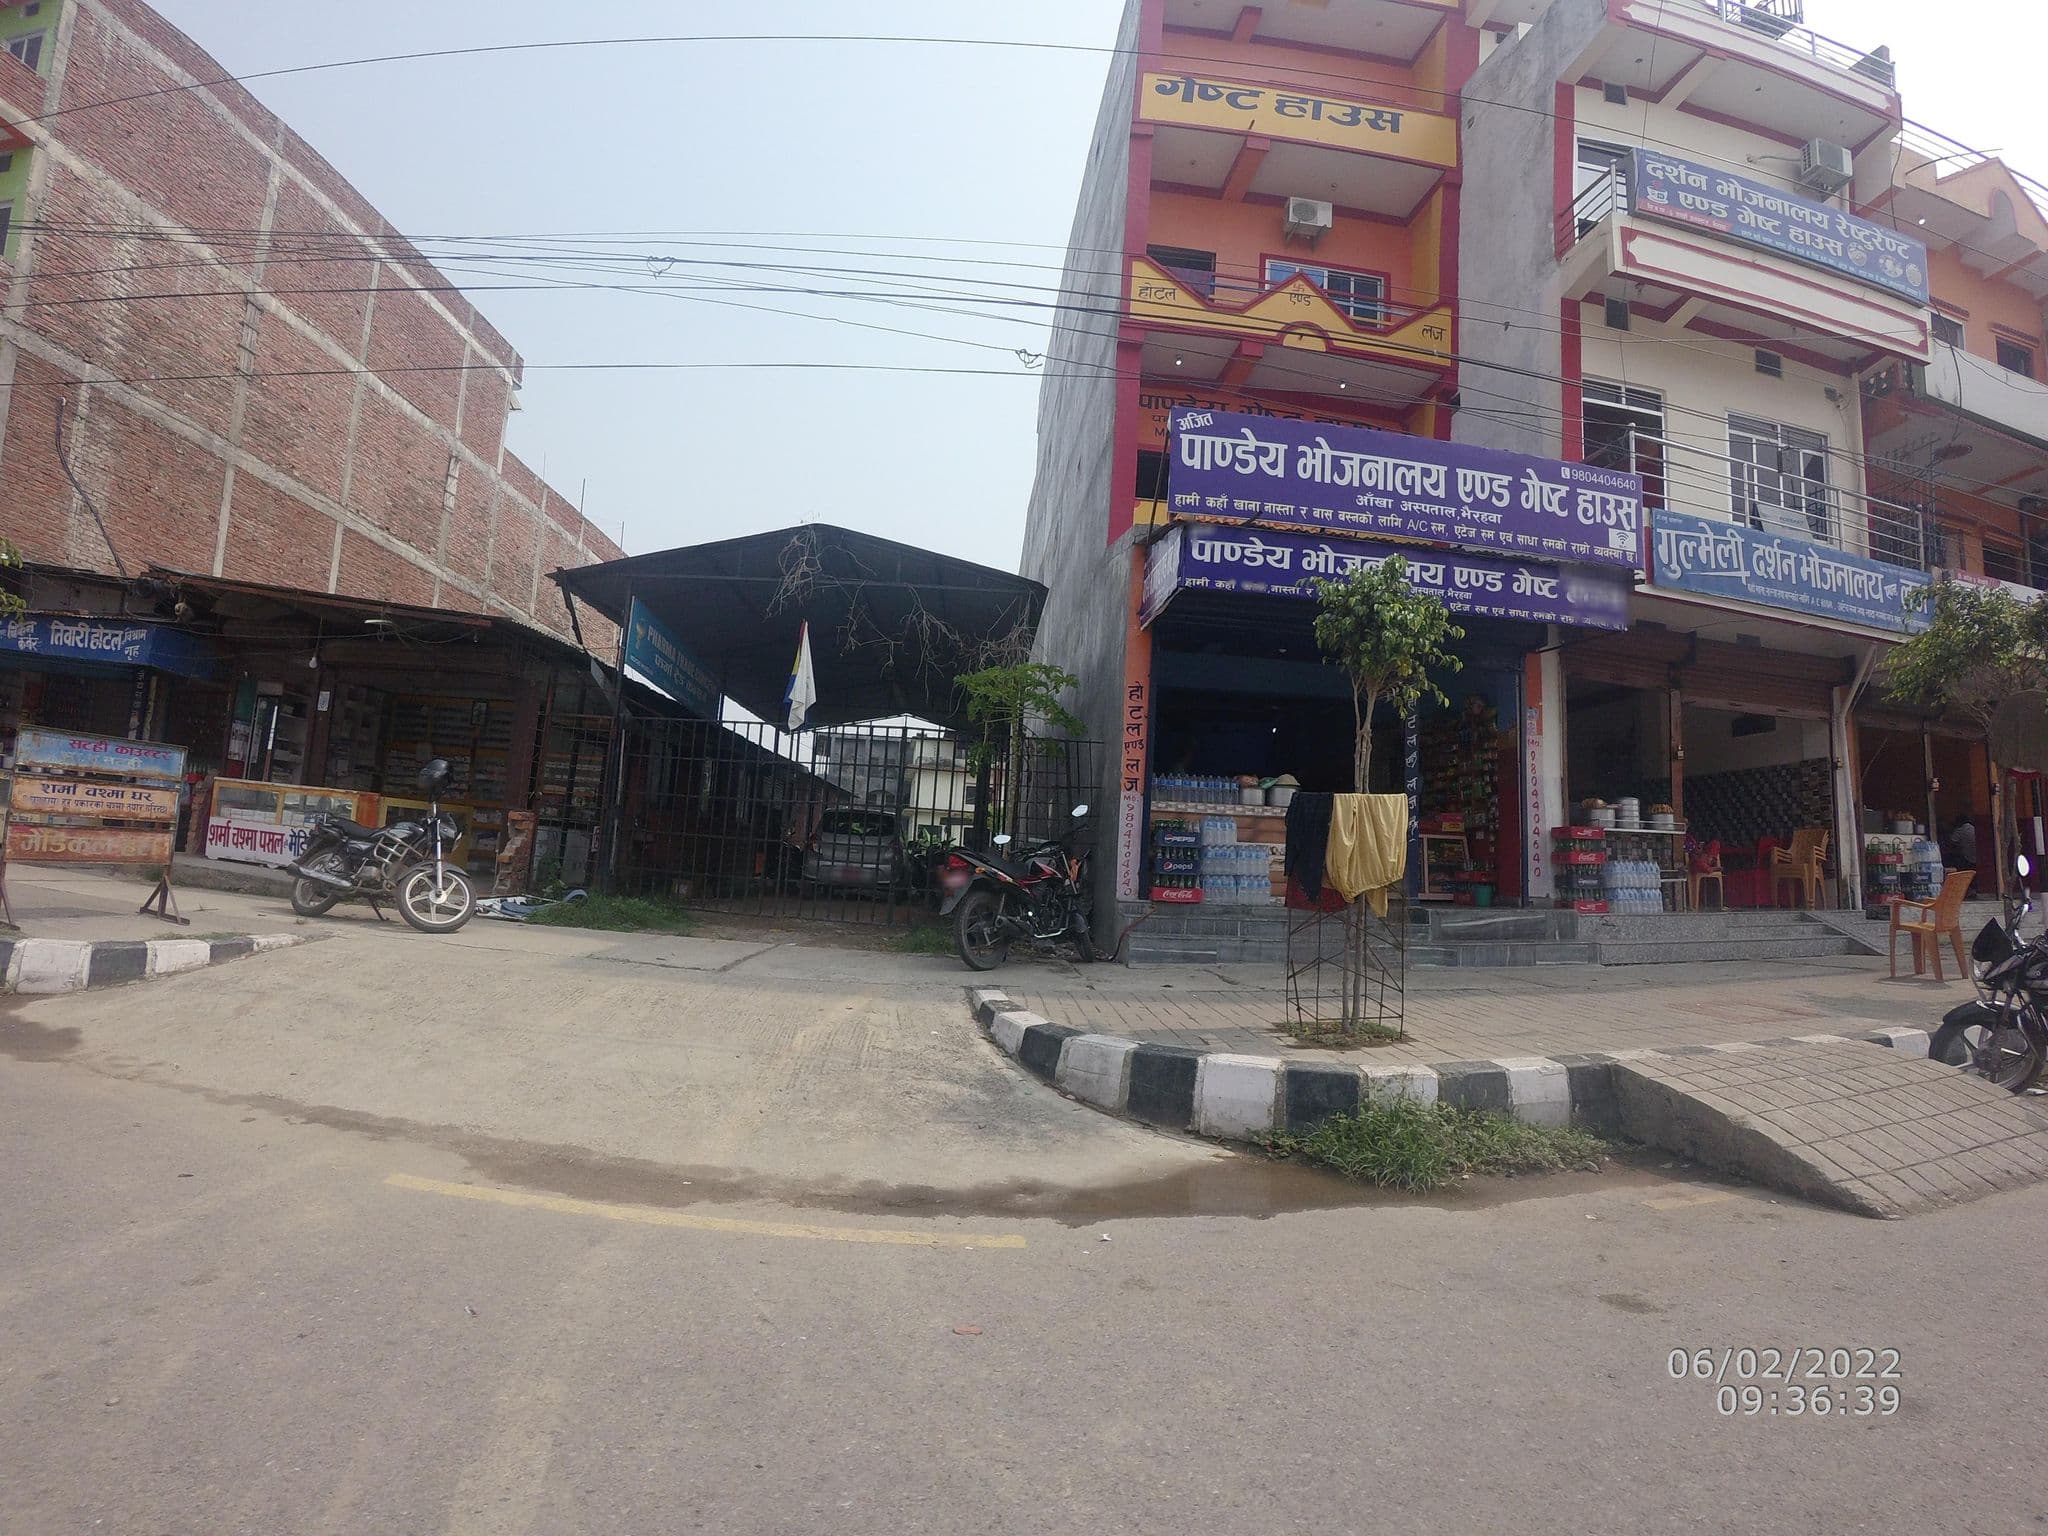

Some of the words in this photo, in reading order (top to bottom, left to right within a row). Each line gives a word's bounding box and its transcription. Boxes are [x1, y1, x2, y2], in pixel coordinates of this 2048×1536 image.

[1155, 77, 1265, 110] गेष्ट
[1274, 93, 1403, 134] हाउस
[1645, 159, 1708, 191] दर्शन
[1716, 178, 1829, 230] भोजनालय
[1678, 191, 1729, 218] एण्ड
[1737, 205, 1782, 235] गेष्ट
[1788, 225, 1843, 257] हाउस
[1138, 285, 1177, 301] होटल
[1289, 291, 1311, 307] एण्ड
[1421, 323, 1446, 342] लज
[1176, 412, 1213, 431] अजित
[1180, 428, 1288, 478] पाण्डेय
[1297, 436, 1447, 498] भोजनालय
[1457, 465, 1512, 508] एण्ड
[1519, 466, 1570, 517] गेष्ट
[1576, 487, 1638, 531] हाउस
[1571, 469, 1637, 491] 9804404640
[1355, 492, 1394, 509] आँखा
[1174, 493, 1200, 507] हामी
[1205, 493, 1229, 511] कहाँ
[1264, 502, 1295, 517] नास्ता
[1299, 506, 1308, 519] र
[1377, 514, 1403, 529] लागि
[1407, 519, 1428, 532] A/C
[1516, 533, 1539, 547] साधा
[1190, 536, 1293, 570] पाण्डेय
[1454, 566, 1504, 592] एण्ड
[1512, 567, 1559, 599] गेष्ट
[1657, 521, 1745, 585] गुल्मेली
[1752, 538, 1797, 584] दर्शन
[1799, 547, 1884, 603] भोजनालय
[1185, 577, 1209, 588] हामी
[1509, 608, 1529, 618] साधा
[50, 619, 90, 648] तिवारी
[90, 624, 124, 651] होटल
[42, 783, 78, 796] शर्मा
[131, 791, 153, 801] घर
[208, 820, 231, 847] शर्मा
[232, 827, 258, 851] चश्मा
